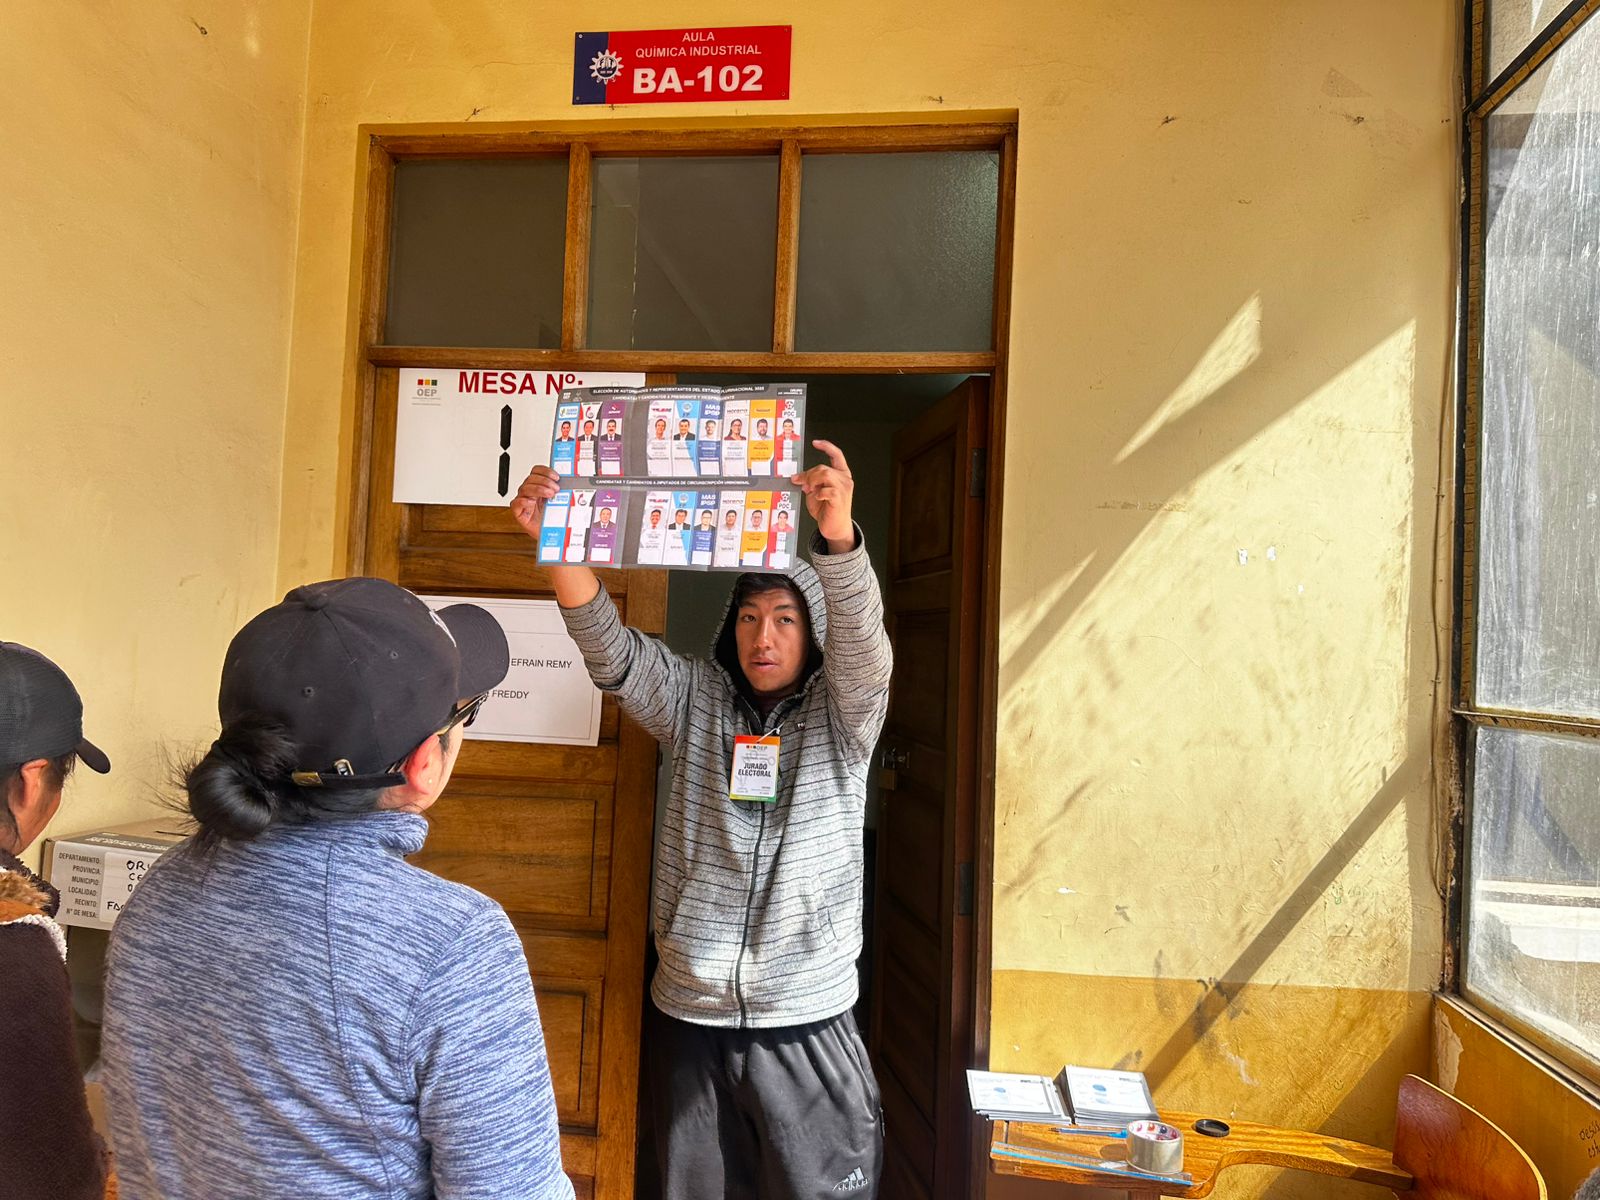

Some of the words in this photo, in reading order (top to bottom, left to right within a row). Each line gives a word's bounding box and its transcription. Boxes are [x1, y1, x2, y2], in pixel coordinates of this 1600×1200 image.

[682, 31, 715, 42] AULA
[635, 46, 686, 58] QUÍMICA
[690, 45, 761, 56] INDUSTRIAL
[633, 65, 763, 94] BA-102
[458, 371, 537, 395] MESA
[416, 388, 437, 397] OEP
[511, 658, 544, 667] EFRAIN
[546, 660, 573, 669] REMY
[492, 689, 529, 699] FREDDY
[738, 769, 771, 778] ELECTORAL
